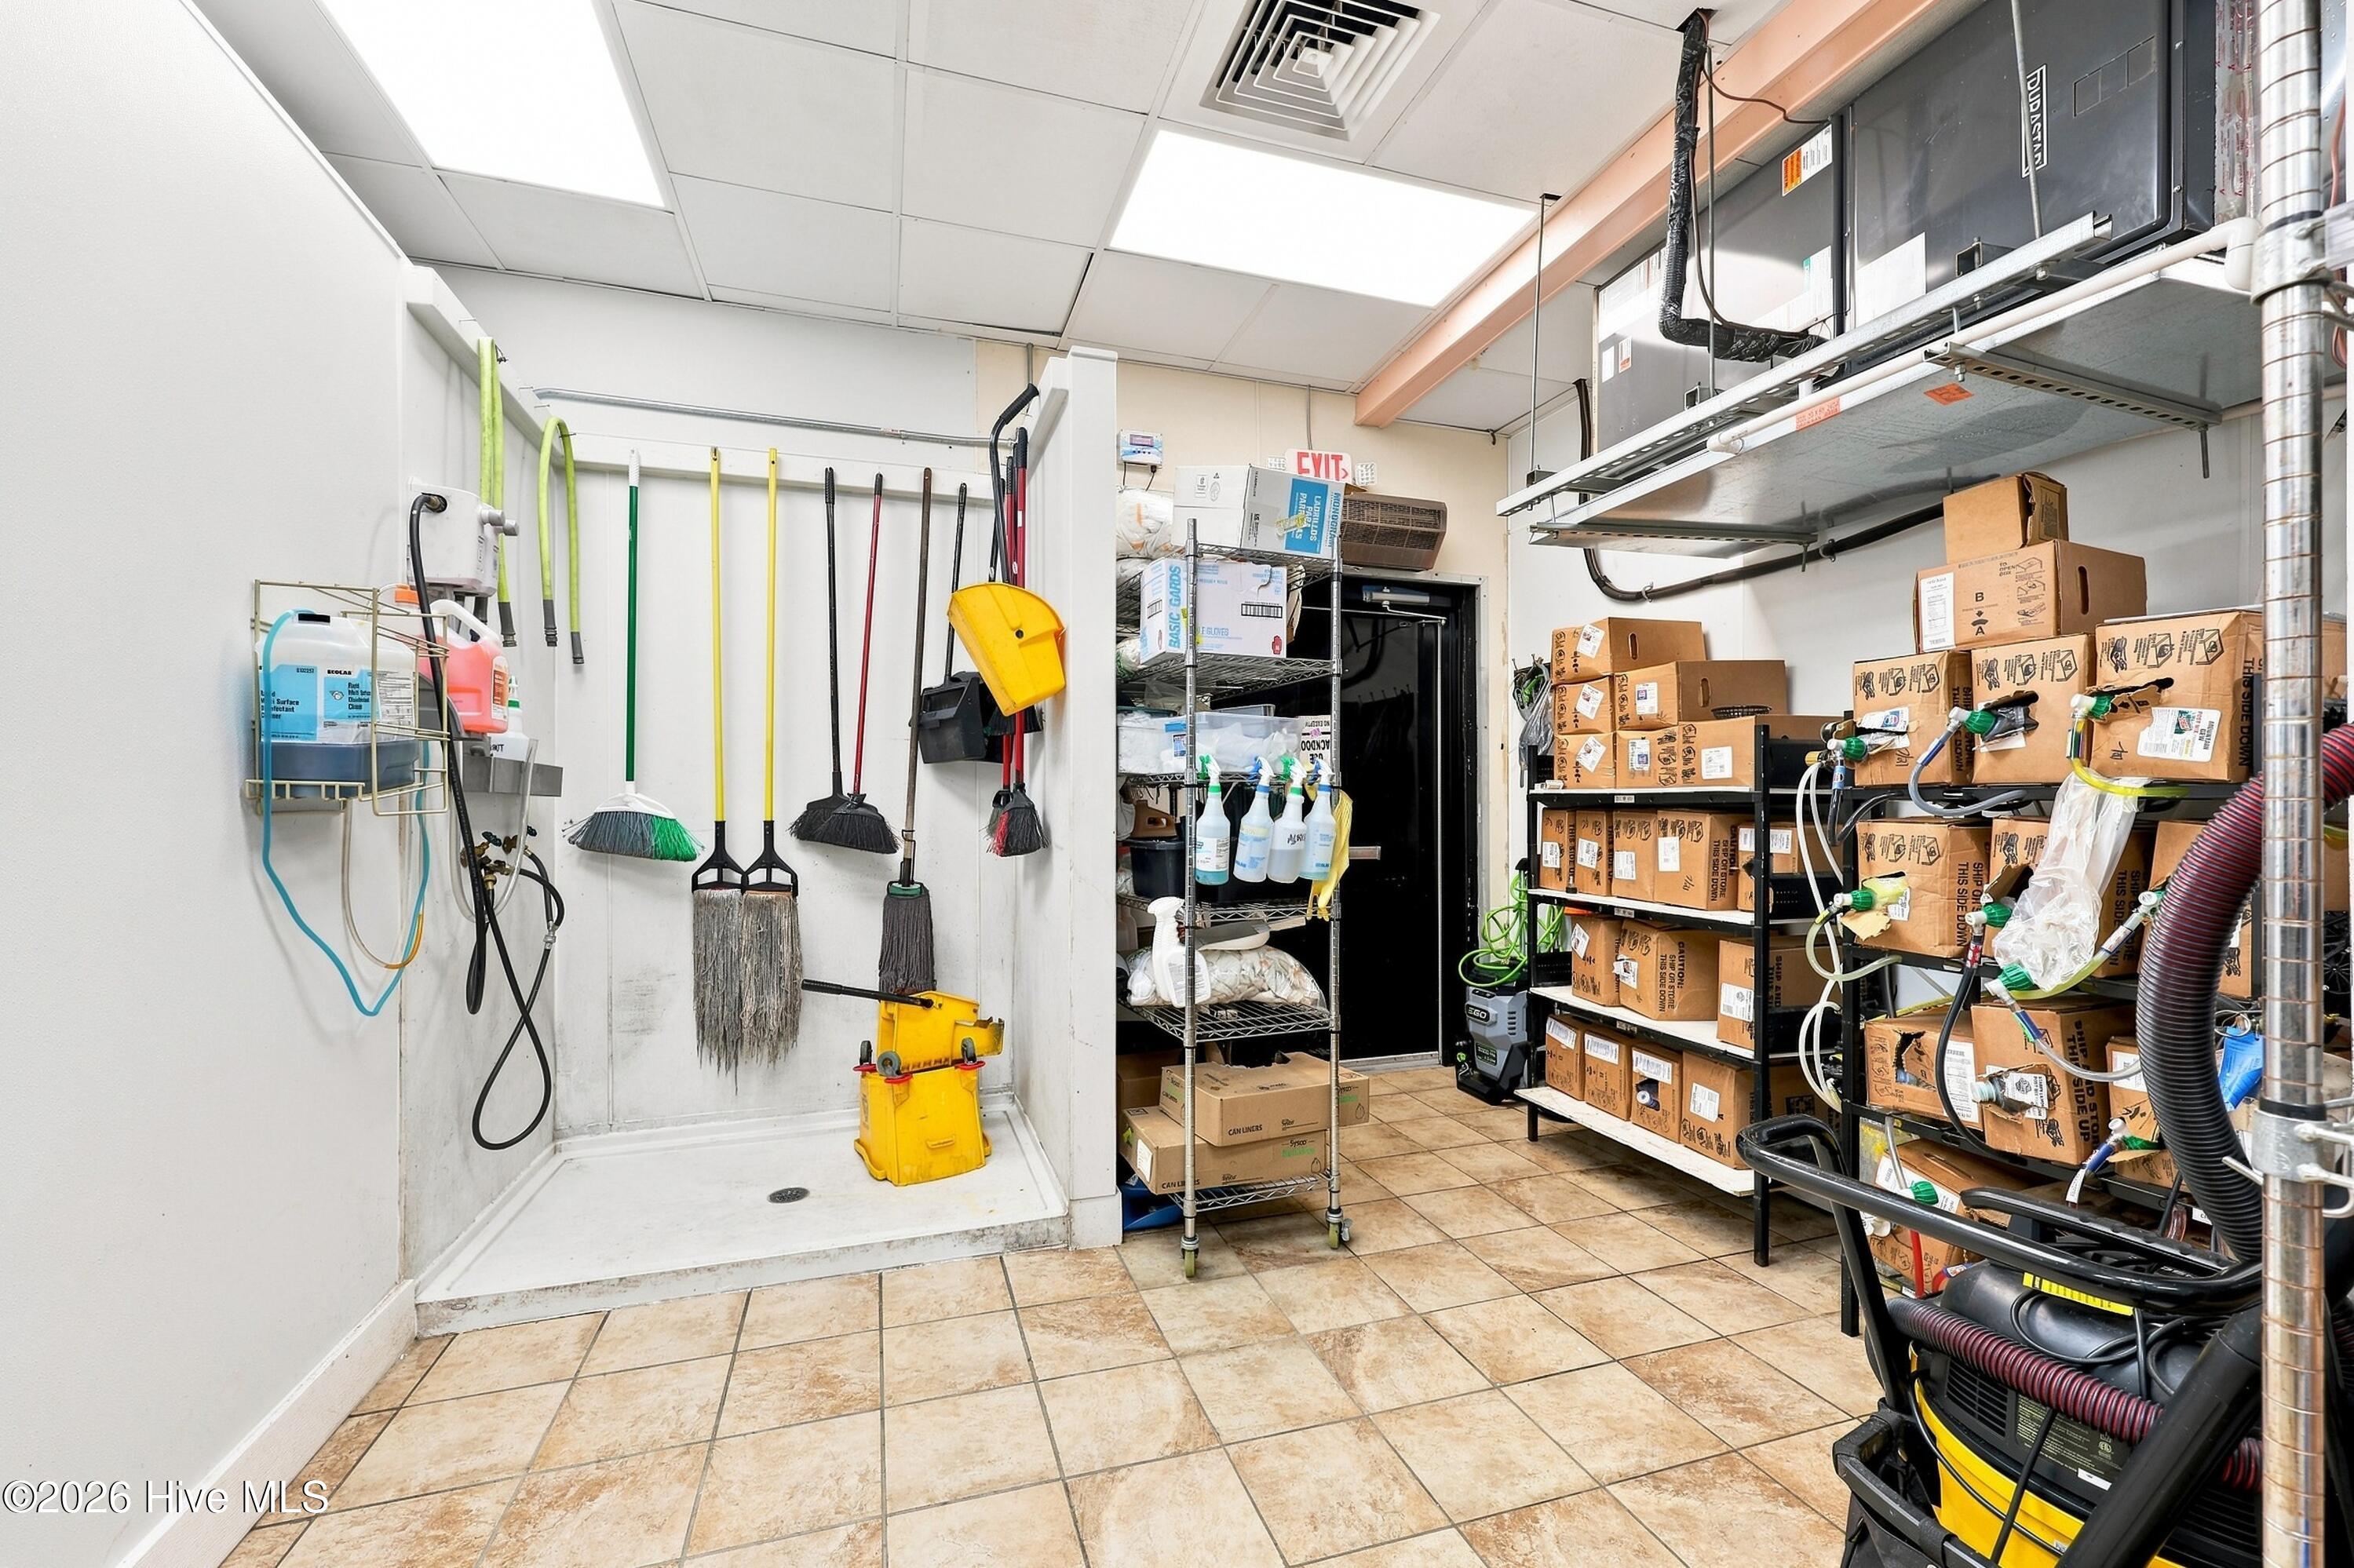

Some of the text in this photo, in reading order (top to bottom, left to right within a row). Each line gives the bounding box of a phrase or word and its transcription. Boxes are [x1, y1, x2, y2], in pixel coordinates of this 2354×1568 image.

[1297, 451, 1343, 482] EXIT
[1310, 495, 1322, 542] LADRILLOS
[1169, 565, 1181, 649] BASIC GARDS
[1975, 592, 1985, 602] B
[1975, 625, 1985, 636] A
[2239, 657, 2255, 768] THIS SIDE DOWN
[2203, 720, 2215, 750] MOUNTAIN
[1973, 862, 1984, 886] SHIP
[2116, 870, 2127, 896] THIS
[1956, 862, 1969, 947] THIS SIDE DOWN
[1669, 974, 1676, 984] OR
[1468, 1007, 1487, 1019] EGO
[2074, 1020, 2088, 1059] SHIP
[2073, 1078, 2086, 1115] SIDE
[1228, 1125, 1263, 1136] CAN LINERS
[1289, 1139, 1308, 1147] Sysco
[2078, 1119, 2090, 1143] UP
